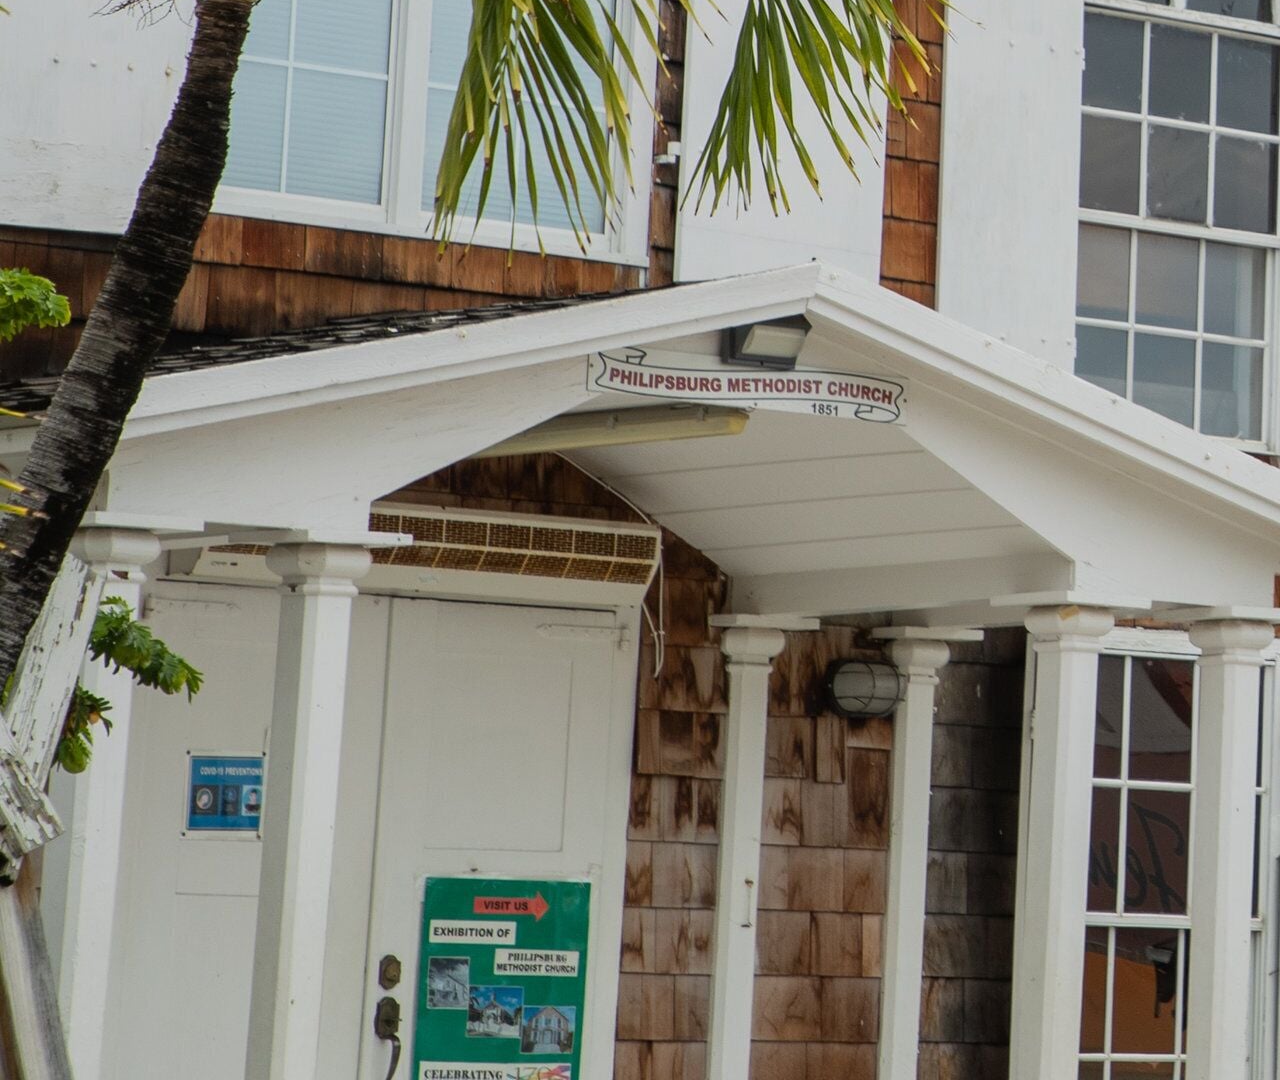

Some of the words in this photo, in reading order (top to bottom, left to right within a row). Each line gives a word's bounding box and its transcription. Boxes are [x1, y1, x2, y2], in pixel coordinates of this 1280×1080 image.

[608, 367, 722, 393] PHILIPSBURG
[727, 377, 823, 395] METHODIST
[827, 380, 893, 405] CHURCH
[811, 402, 839, 417] 1851
[484, 901, 512, 911] VISIT
[514, 901, 528, 911] US
[433, 927, 494, 938] EXHIBITION
[497, 928, 511, 938] OF
[507, 953, 567, 963] PHILIPSBURG
[496, 963, 542, 972] METHODIST
[545, 964, 575, 973] CHURCH
[424, 1070, 503, 1080] CELEBRATING
